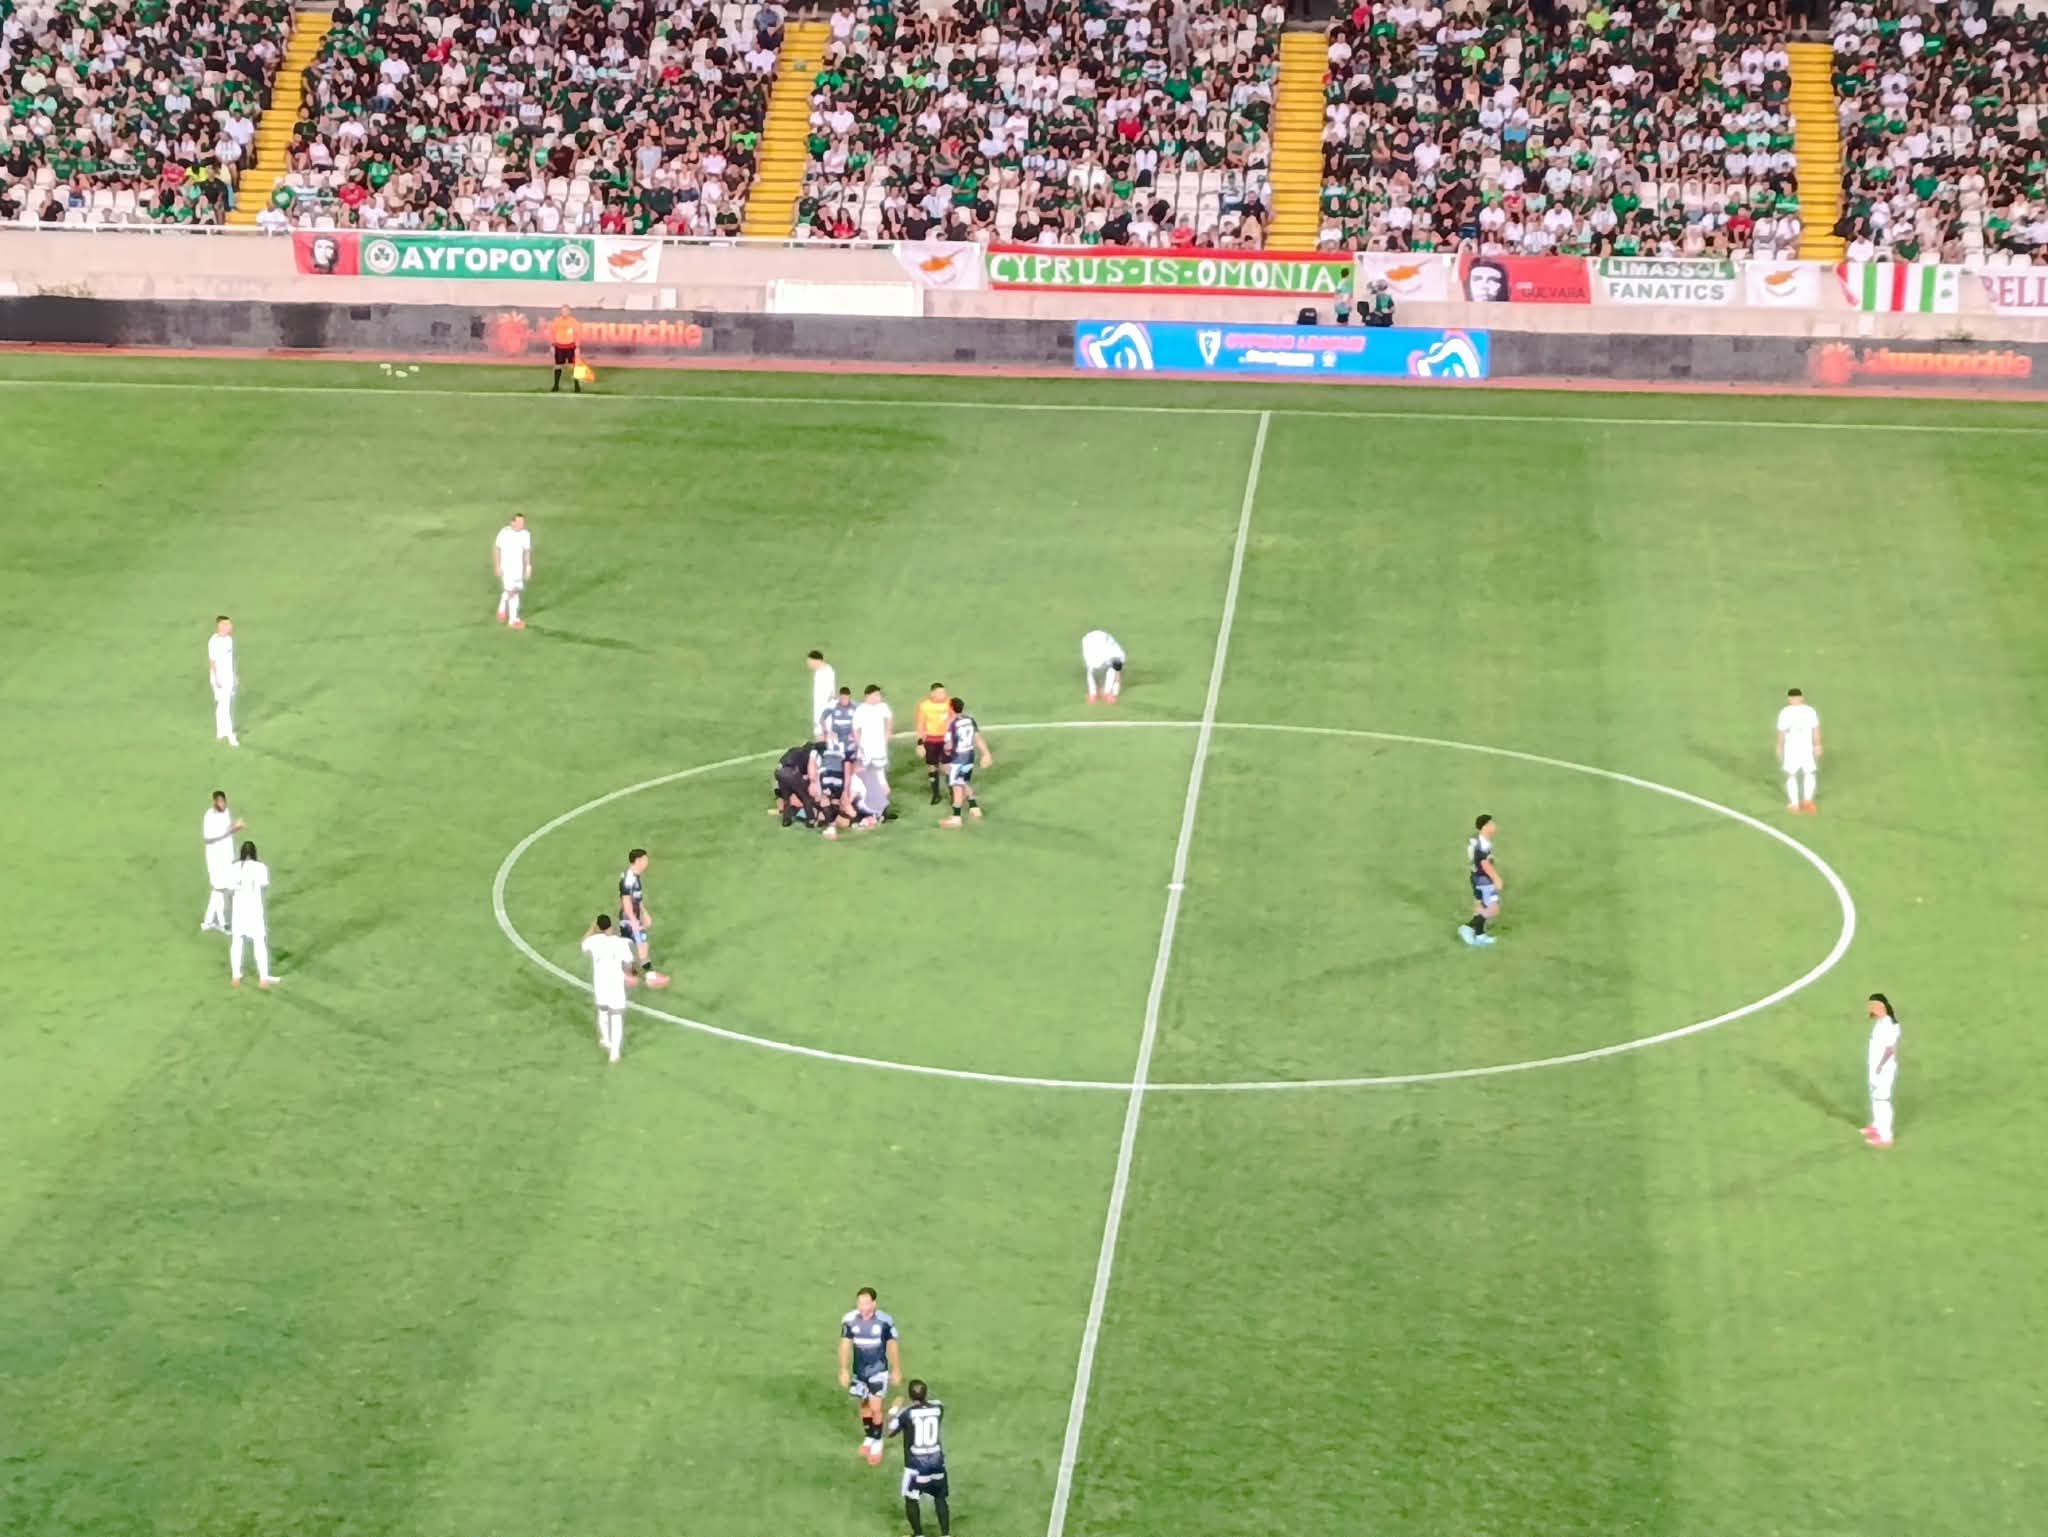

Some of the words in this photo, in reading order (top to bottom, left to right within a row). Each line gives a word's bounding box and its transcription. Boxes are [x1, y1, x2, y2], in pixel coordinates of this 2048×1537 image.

[1607, 260, 1728, 277] LIMASSOL
[1609, 282, 1726, 301] FANATICS
[912, 1415, 938, 1447] 10
